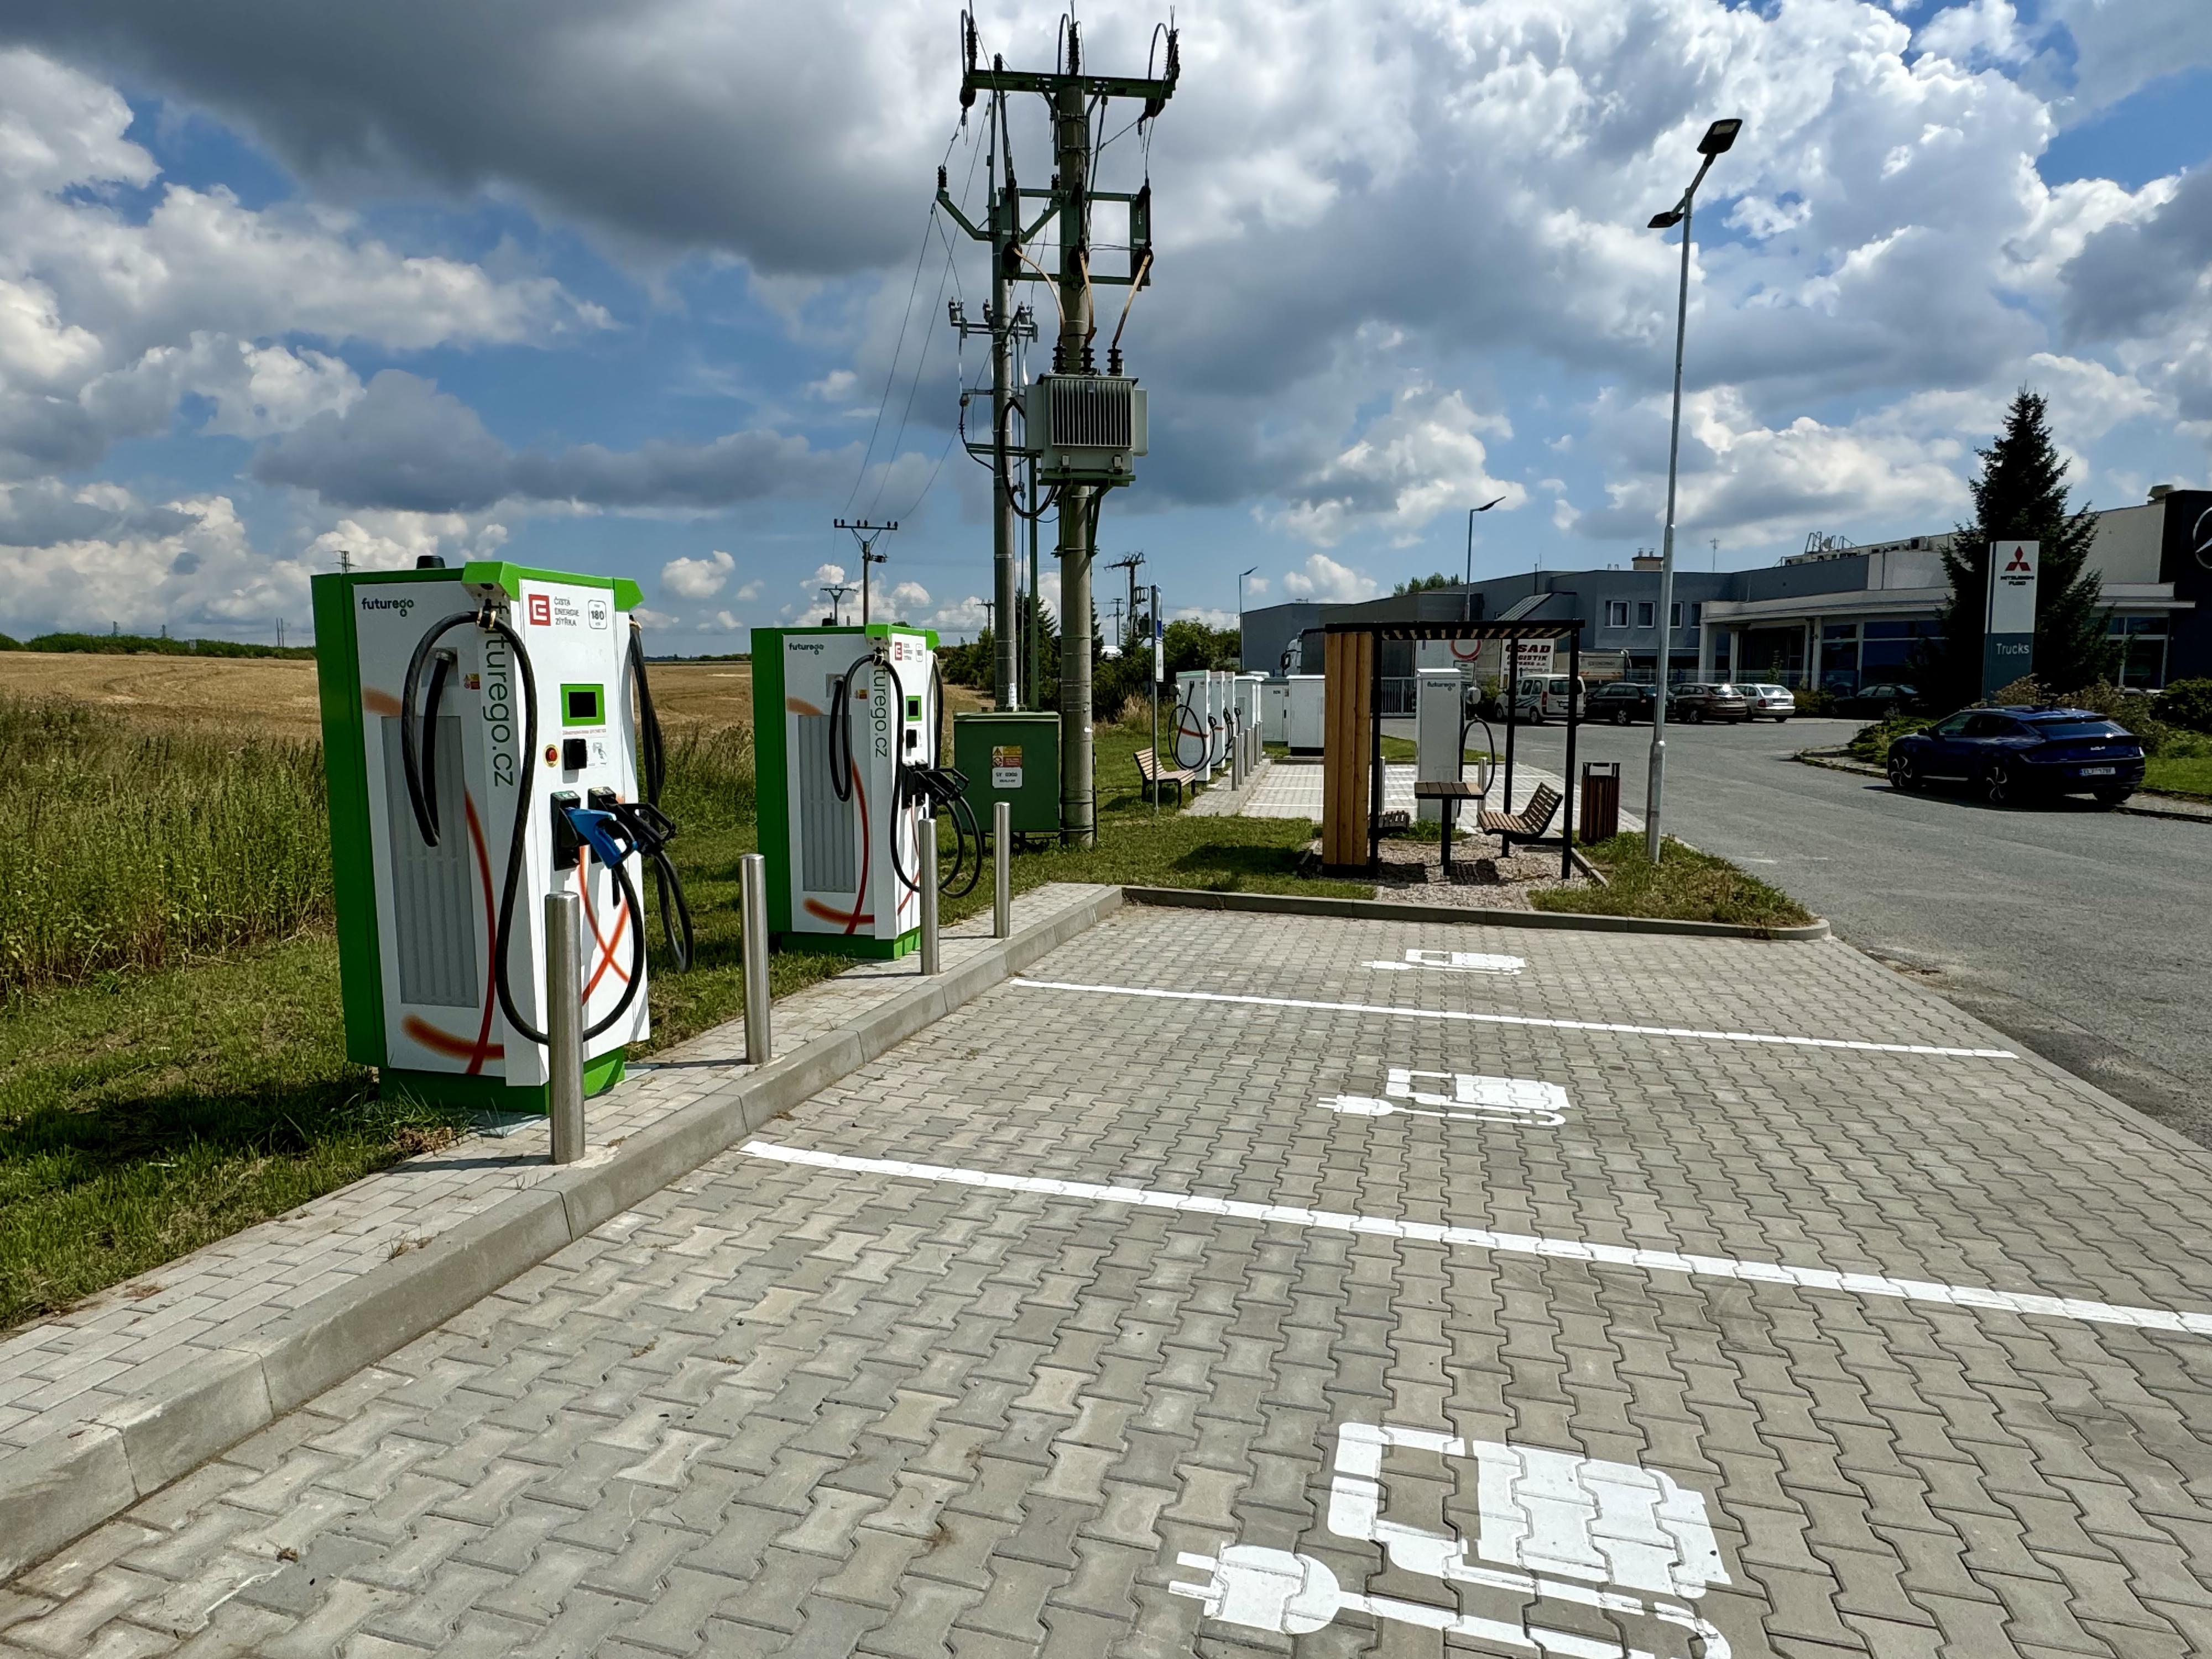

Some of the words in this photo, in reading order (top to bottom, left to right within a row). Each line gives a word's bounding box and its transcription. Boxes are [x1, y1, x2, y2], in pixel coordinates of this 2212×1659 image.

[362, 597, 414, 617] futurego
[591, 611, 604, 620] 180
[789, 643, 824, 655] futurego
[1996, 643, 2030, 655] Trucks
[483, 602, 513, 786] fturego.cz
